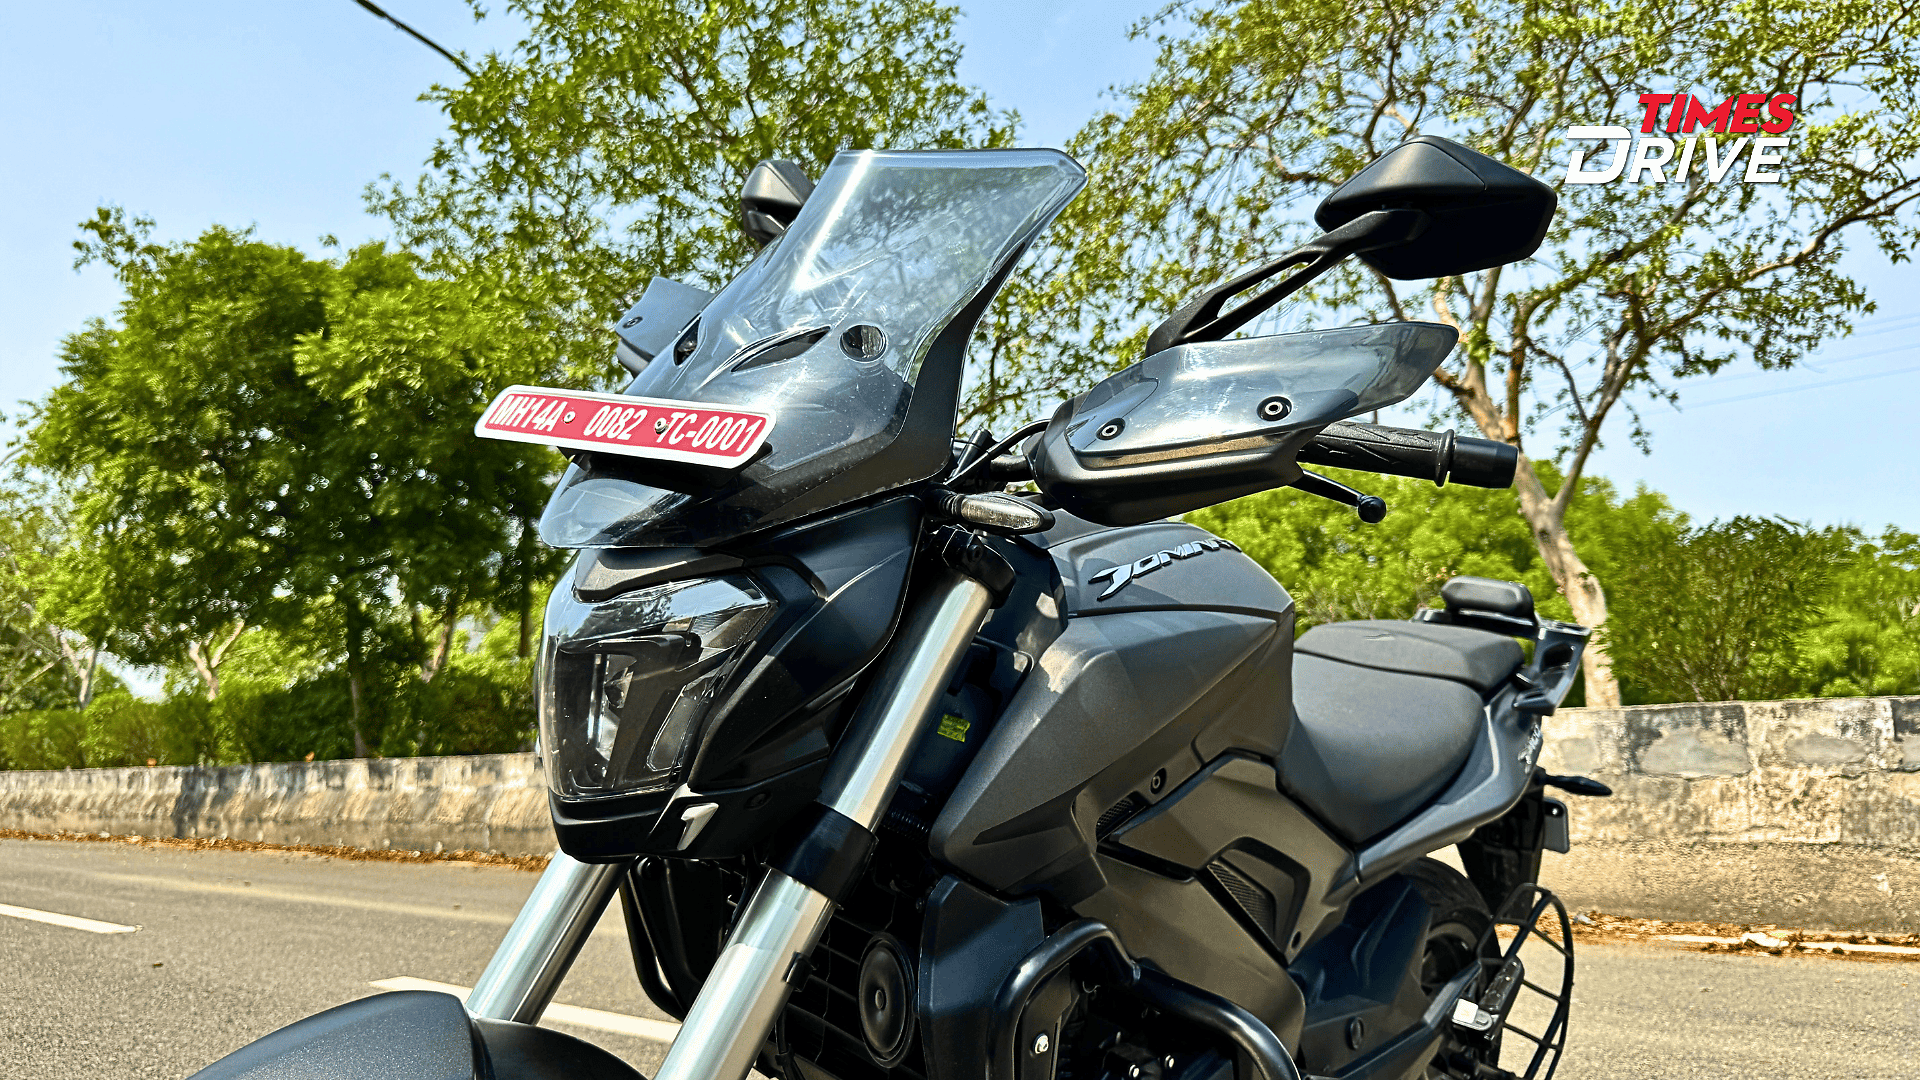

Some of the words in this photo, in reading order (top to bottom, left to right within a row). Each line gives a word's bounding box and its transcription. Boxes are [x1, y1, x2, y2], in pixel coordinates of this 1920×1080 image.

[488, 394, 568, 432] MH14A
[583, 404, 648, 440] 0082
[656, 412, 763, 452] TC-0001
